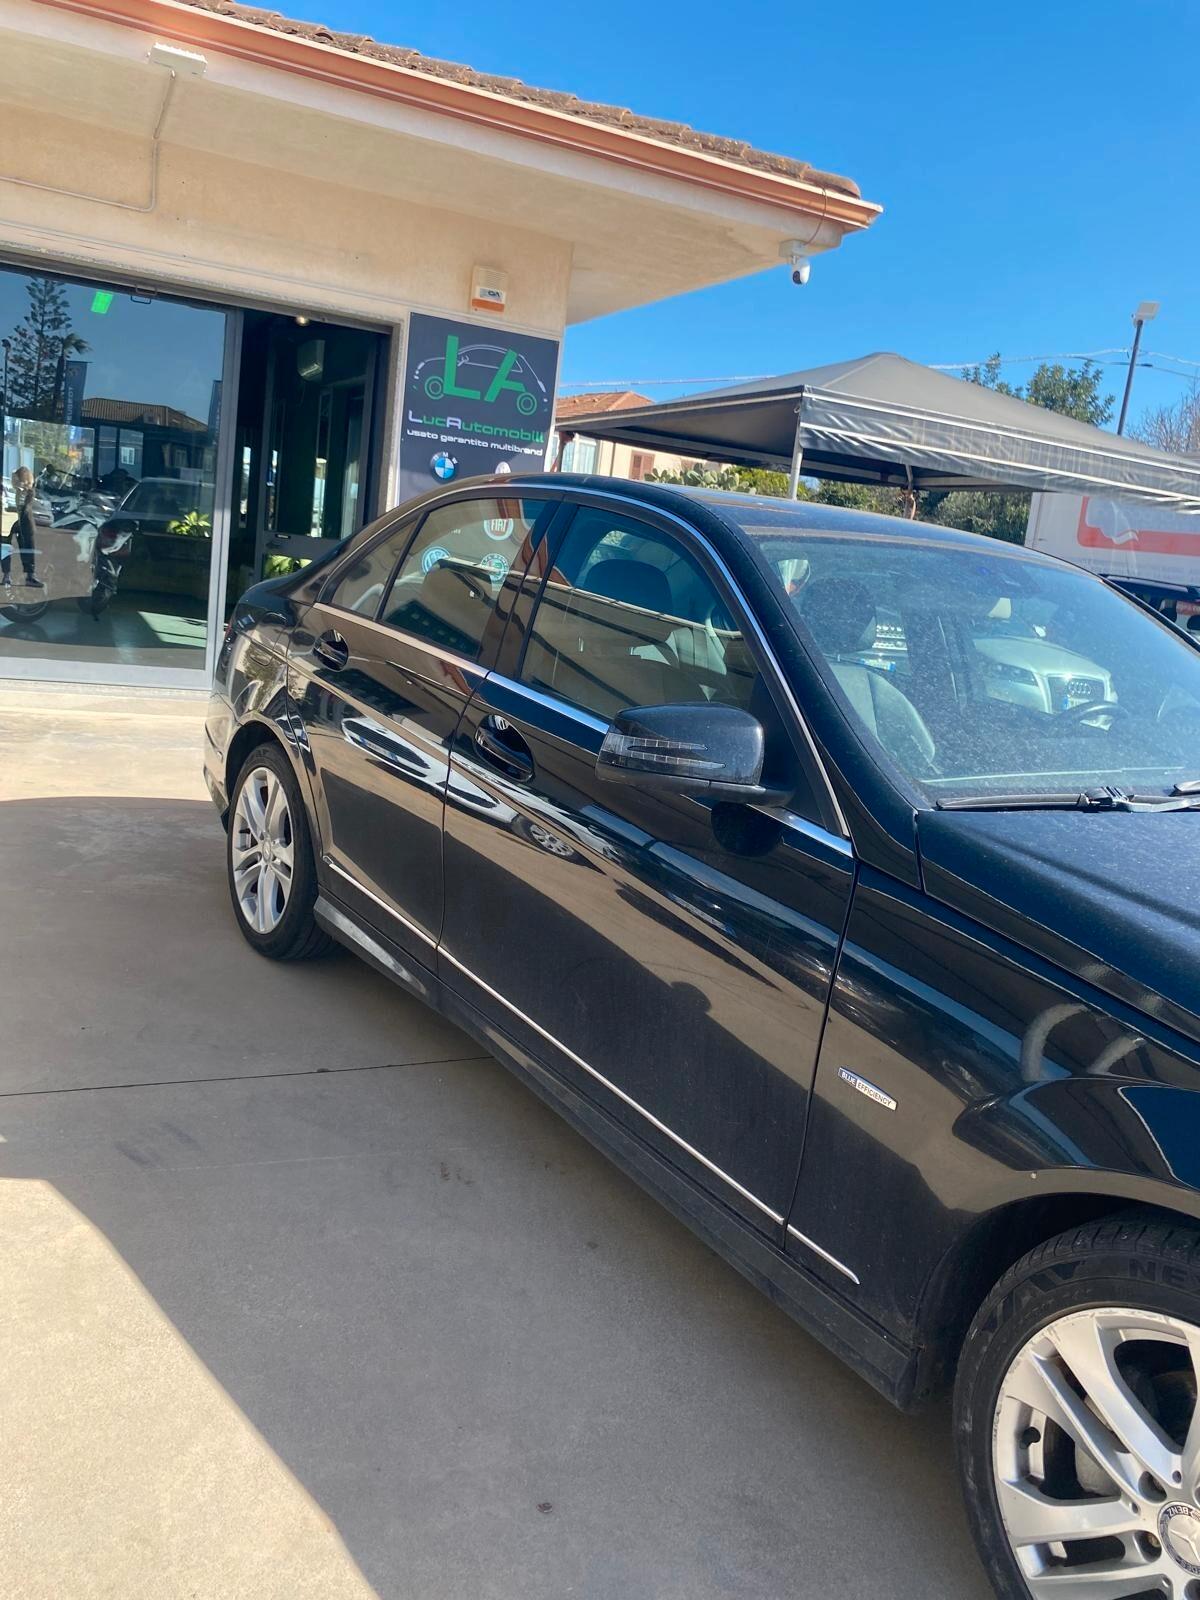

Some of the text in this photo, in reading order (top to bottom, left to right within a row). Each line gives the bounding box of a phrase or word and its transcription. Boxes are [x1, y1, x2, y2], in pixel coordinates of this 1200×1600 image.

[406, 429, 544, 456] usato garantito multibrand
[841, 1071, 892, 1106] BLUE EFFICIENCY
[1166, 1505, 1189, 1518] BENZ
